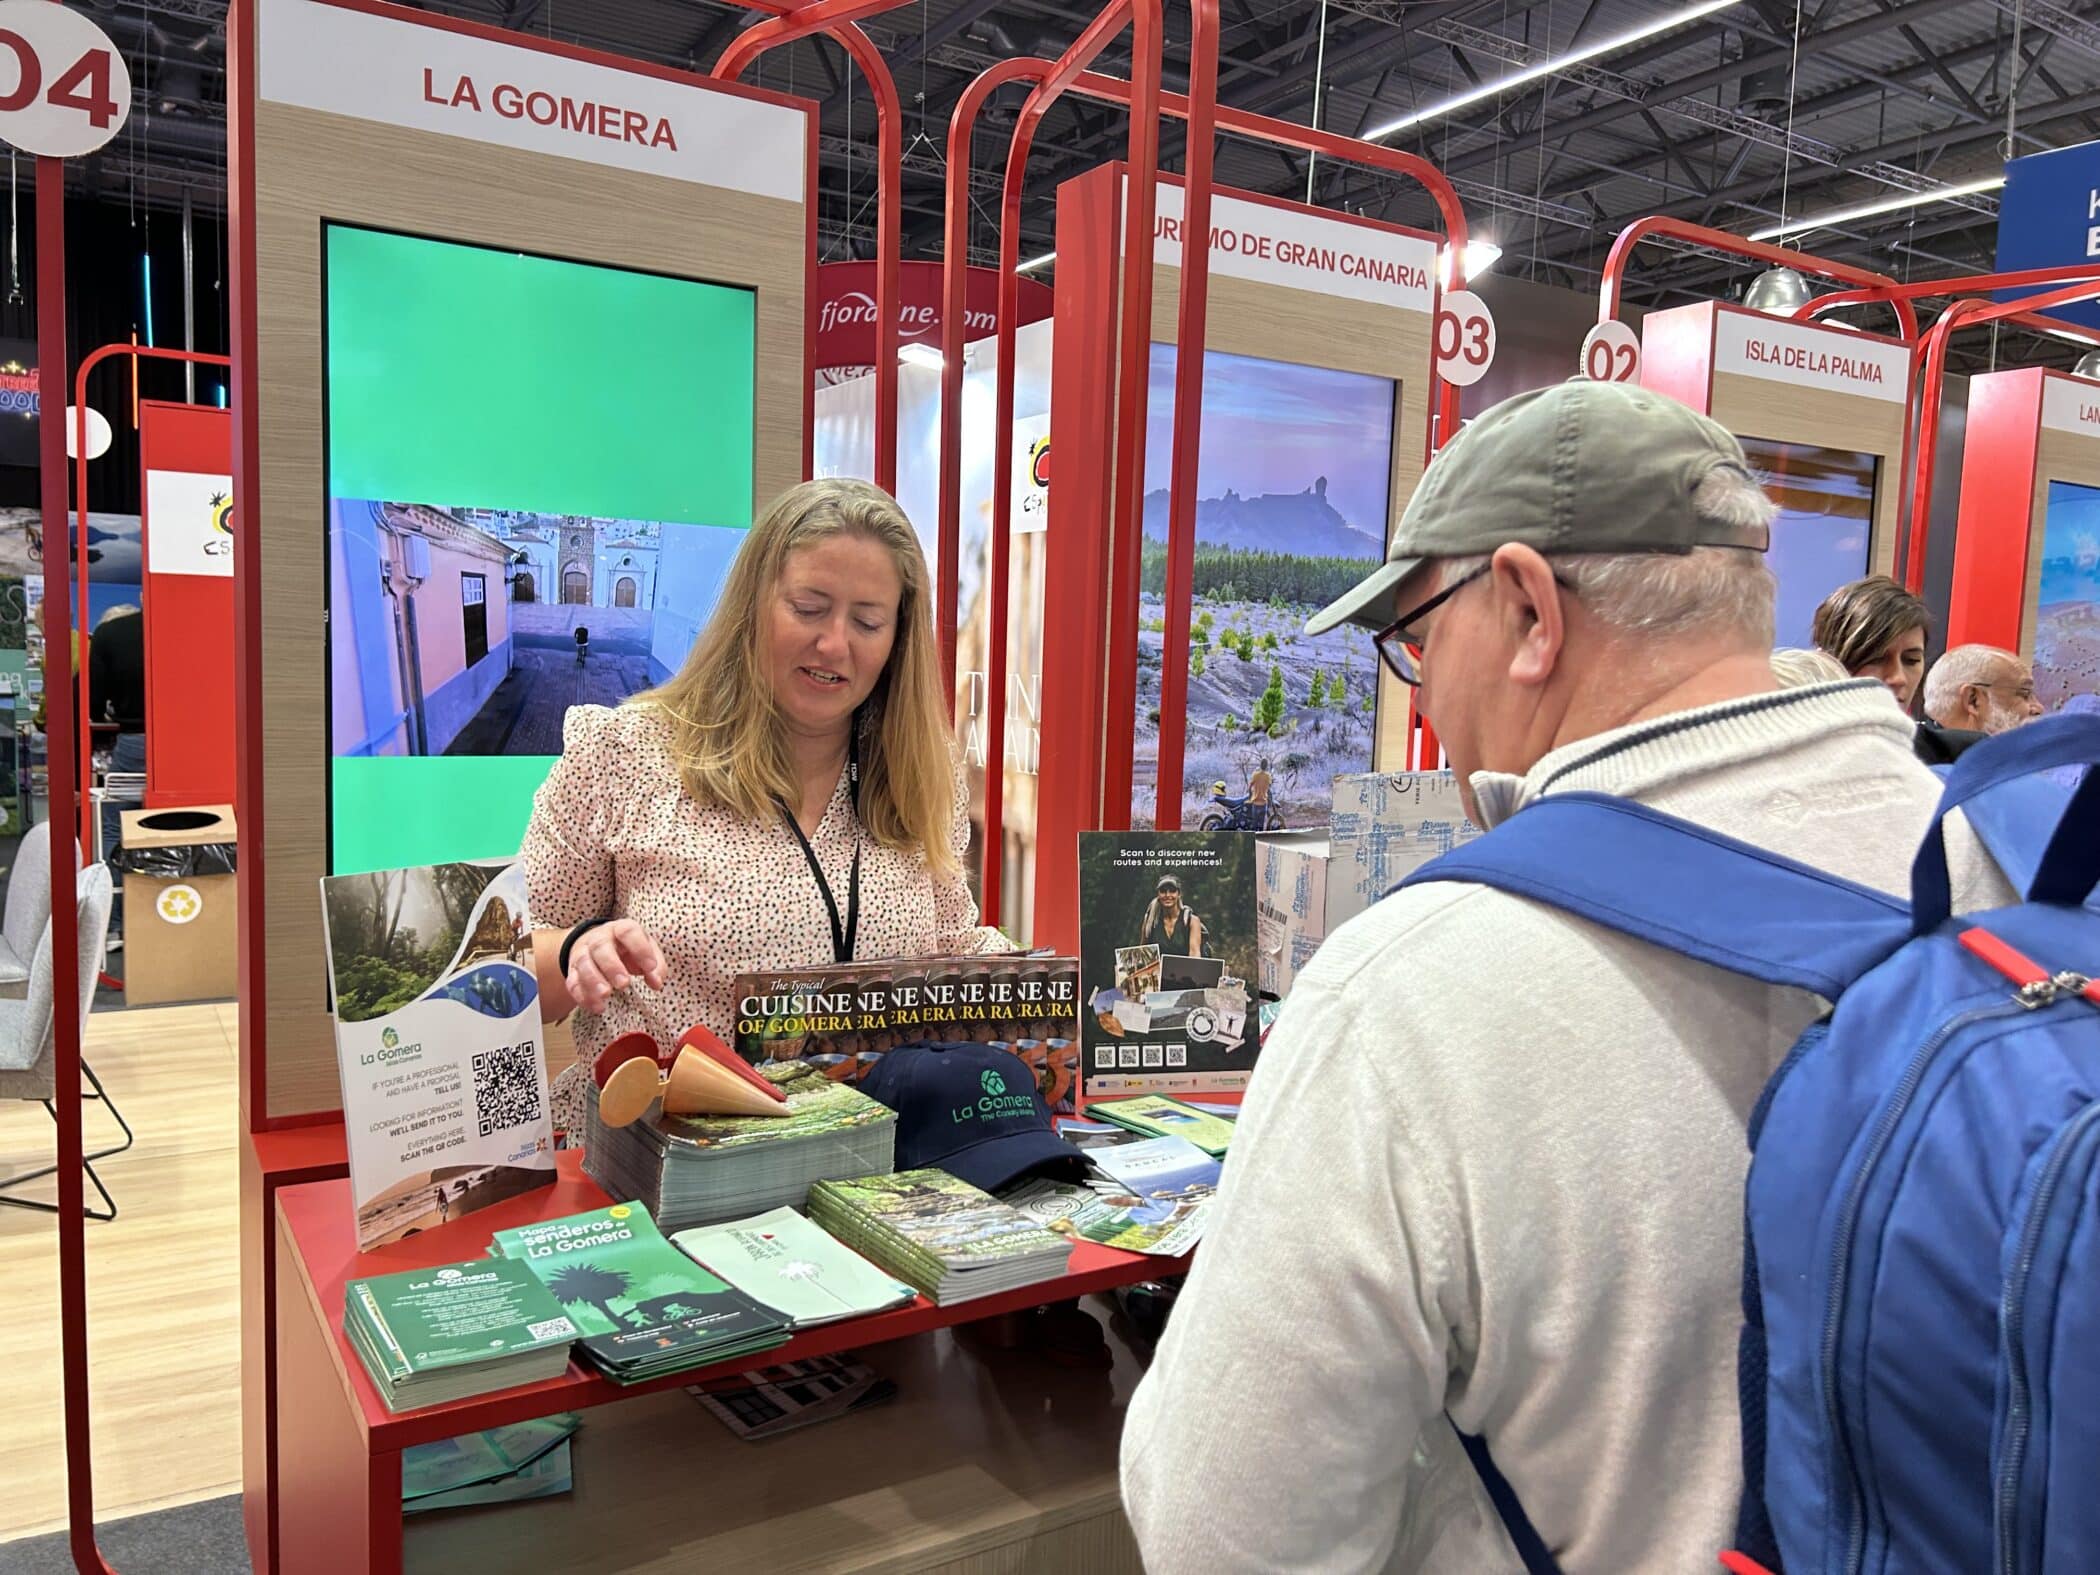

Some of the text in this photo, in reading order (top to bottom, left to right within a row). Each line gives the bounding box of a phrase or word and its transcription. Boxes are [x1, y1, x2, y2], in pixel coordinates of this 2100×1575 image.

[0, 27, 118, 130] 04
[423, 67, 679, 153] LA GOMERA
[1153, 215, 1428, 291] URIMO DE GRAN CANARIA
[1438, 310, 1490, 366] 03
[1587, 338, 1637, 382] 02
[1745, 339, 1883, 384] ISLA DE LA PALMA
[1113, 857, 1223, 867] routes and experiences!
[1120, 849, 1143, 857] Scan
[1146, 849, 1156, 857] to
[1157, 849, 1196, 857] discover
[770, 977, 826, 995] The Typical
[740, 993, 852, 1017] CUISINE
[923, 1006, 956, 1022] ERA
[738, 1015, 852, 1035] OF GOMERA
[361, 1043, 422, 1066] La Gomera
[406, 1075, 412, 1083] A
[412, 1062, 460, 1081] PROFESSIONAL
[386, 1072, 461, 1098] AND HAVE A PROPOSAL
[435, 1085, 449, 1096] TELL
[952, 1095, 1033, 1123] La Gomera
[370, 1117, 401, 1133] LOOKING
[401, 1112, 416, 1123] FOR
[390, 1124, 410, 1138] WE'LL
[410, 1120, 429, 1132] SEND
[430, 1117, 436, 1127] IT
[437, 1114, 447, 1125] TO
[408, 1131, 448, 1151] EVERYTHING
[400, 1150, 421, 1163] SCAN
[422, 1146, 435, 1157] THE
[518, 1225, 557, 1239] Mapa
[523, 1219, 613, 1247] senderos
[527, 1227, 633, 1259] La Gomera
[409, 1282, 430, 1290] La
[433, 1272, 497, 1287] Gomera
